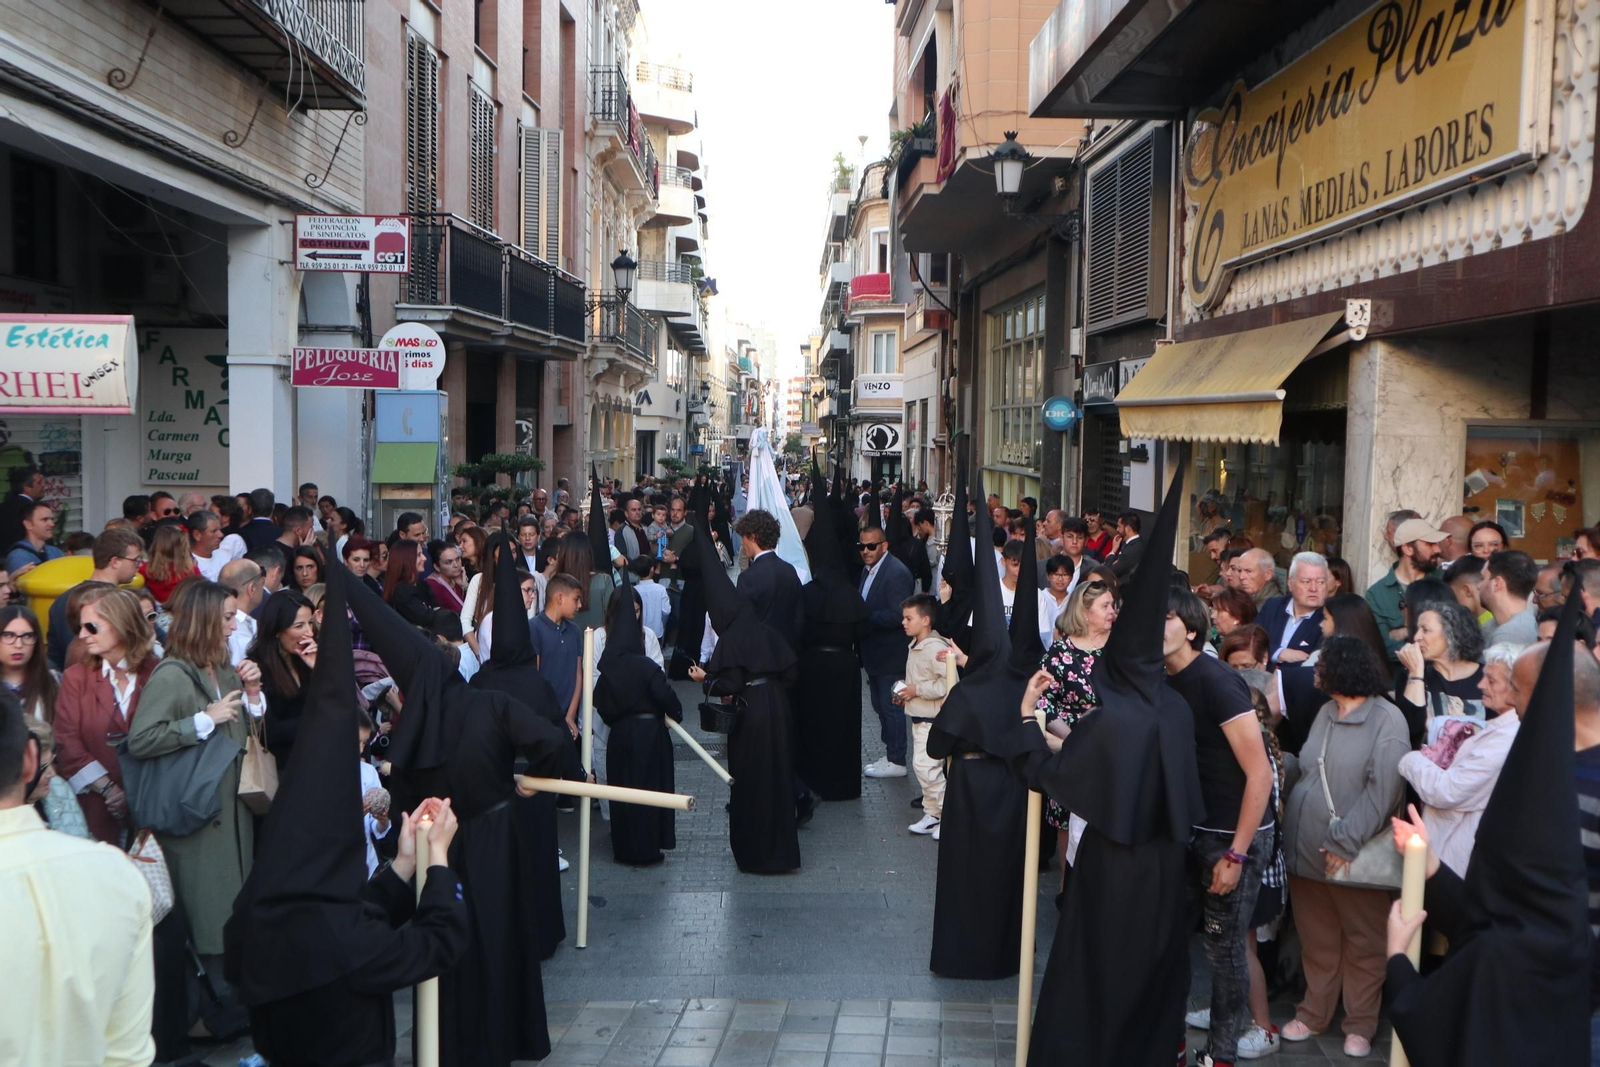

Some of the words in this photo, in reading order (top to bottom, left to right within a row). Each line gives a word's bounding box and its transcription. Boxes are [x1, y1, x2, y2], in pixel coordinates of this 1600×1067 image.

[1359, 0, 1515, 105] Plaza
[1384, 102, 1495, 197] LABORES
[308, 217, 361, 225] FEDERACION
[317, 231, 366, 239] SINDICATOS
[301, 239, 368, 249] CGT-HUELVA
[376, 251, 404, 263] CGT
[324, 262, 331, 270] 25
[5, 325, 109, 349] Estética
[294, 348, 398, 373] PELUQUERIA
[411, 358, 433, 368] días
[81, 358, 119, 388] UNISEX
[863, 382, 891, 390] VENZO
[148, 410, 176, 423] Lda.
[1045, 409, 1075, 418] DIGI
[148, 429, 200, 442] Carmen
[148, 448, 192, 465] Murga
[148, 468, 200, 481] Pascual
